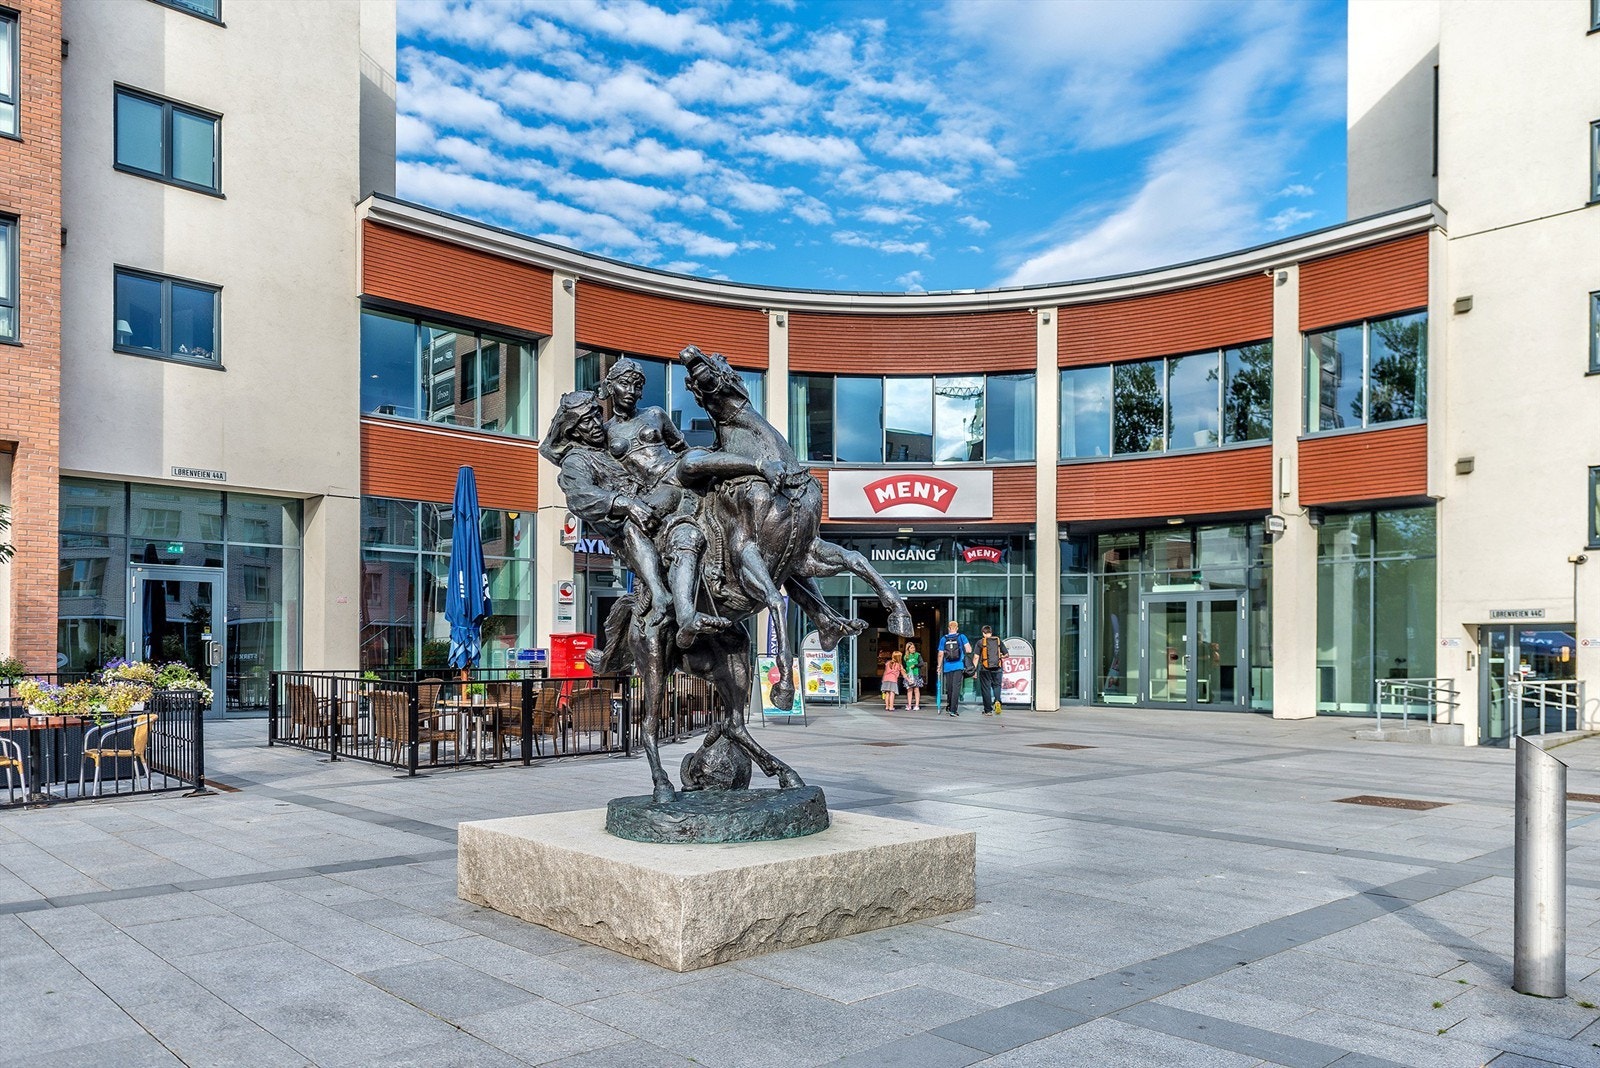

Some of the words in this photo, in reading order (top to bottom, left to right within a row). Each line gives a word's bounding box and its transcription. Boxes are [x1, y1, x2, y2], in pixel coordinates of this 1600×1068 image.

[174, 468, 210, 478] LØRENVEIEN
[874, 481, 948, 503] MENY
[575, 538, 615, 555] AYN
[871, 549, 936, 560] INNGANG
[966, 549, 998, 559] MENY
[906, 580, 928, 591] (20)
[1492, 609, 1528, 618] LØRENVEIEN
